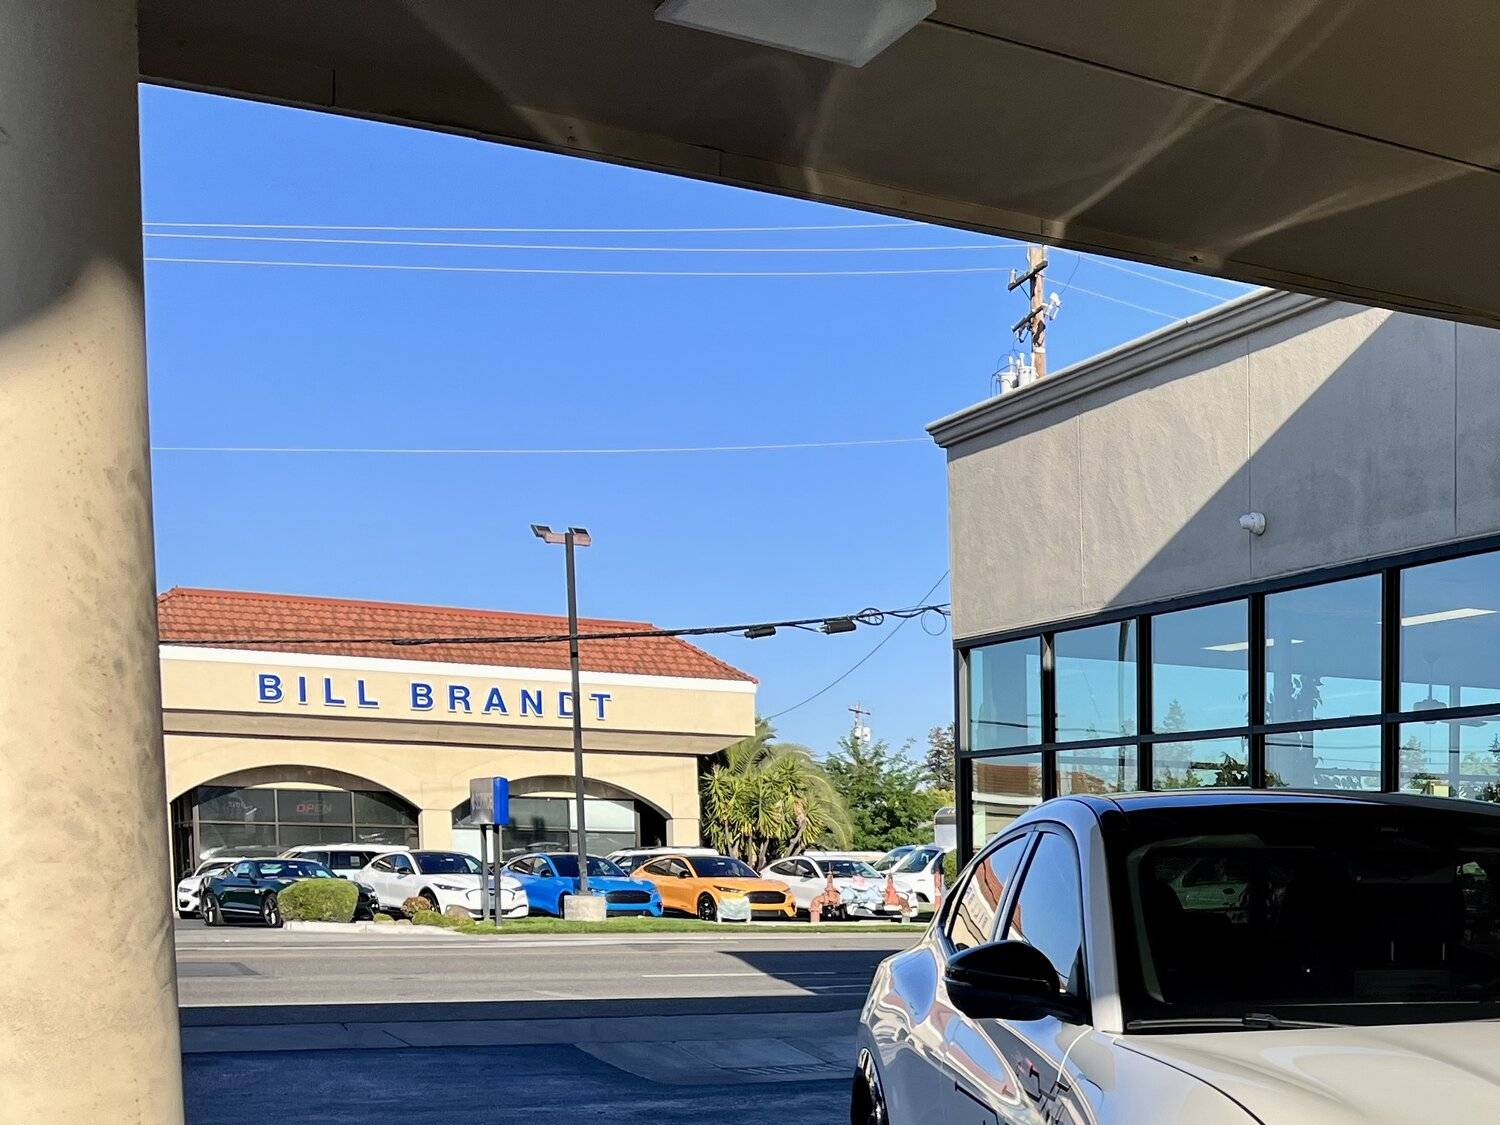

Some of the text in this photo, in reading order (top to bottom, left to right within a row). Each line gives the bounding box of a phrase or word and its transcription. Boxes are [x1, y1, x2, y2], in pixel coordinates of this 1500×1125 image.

[258, 673, 612, 720] BILL BRANDT
[296, 803, 332, 814] OPEN
